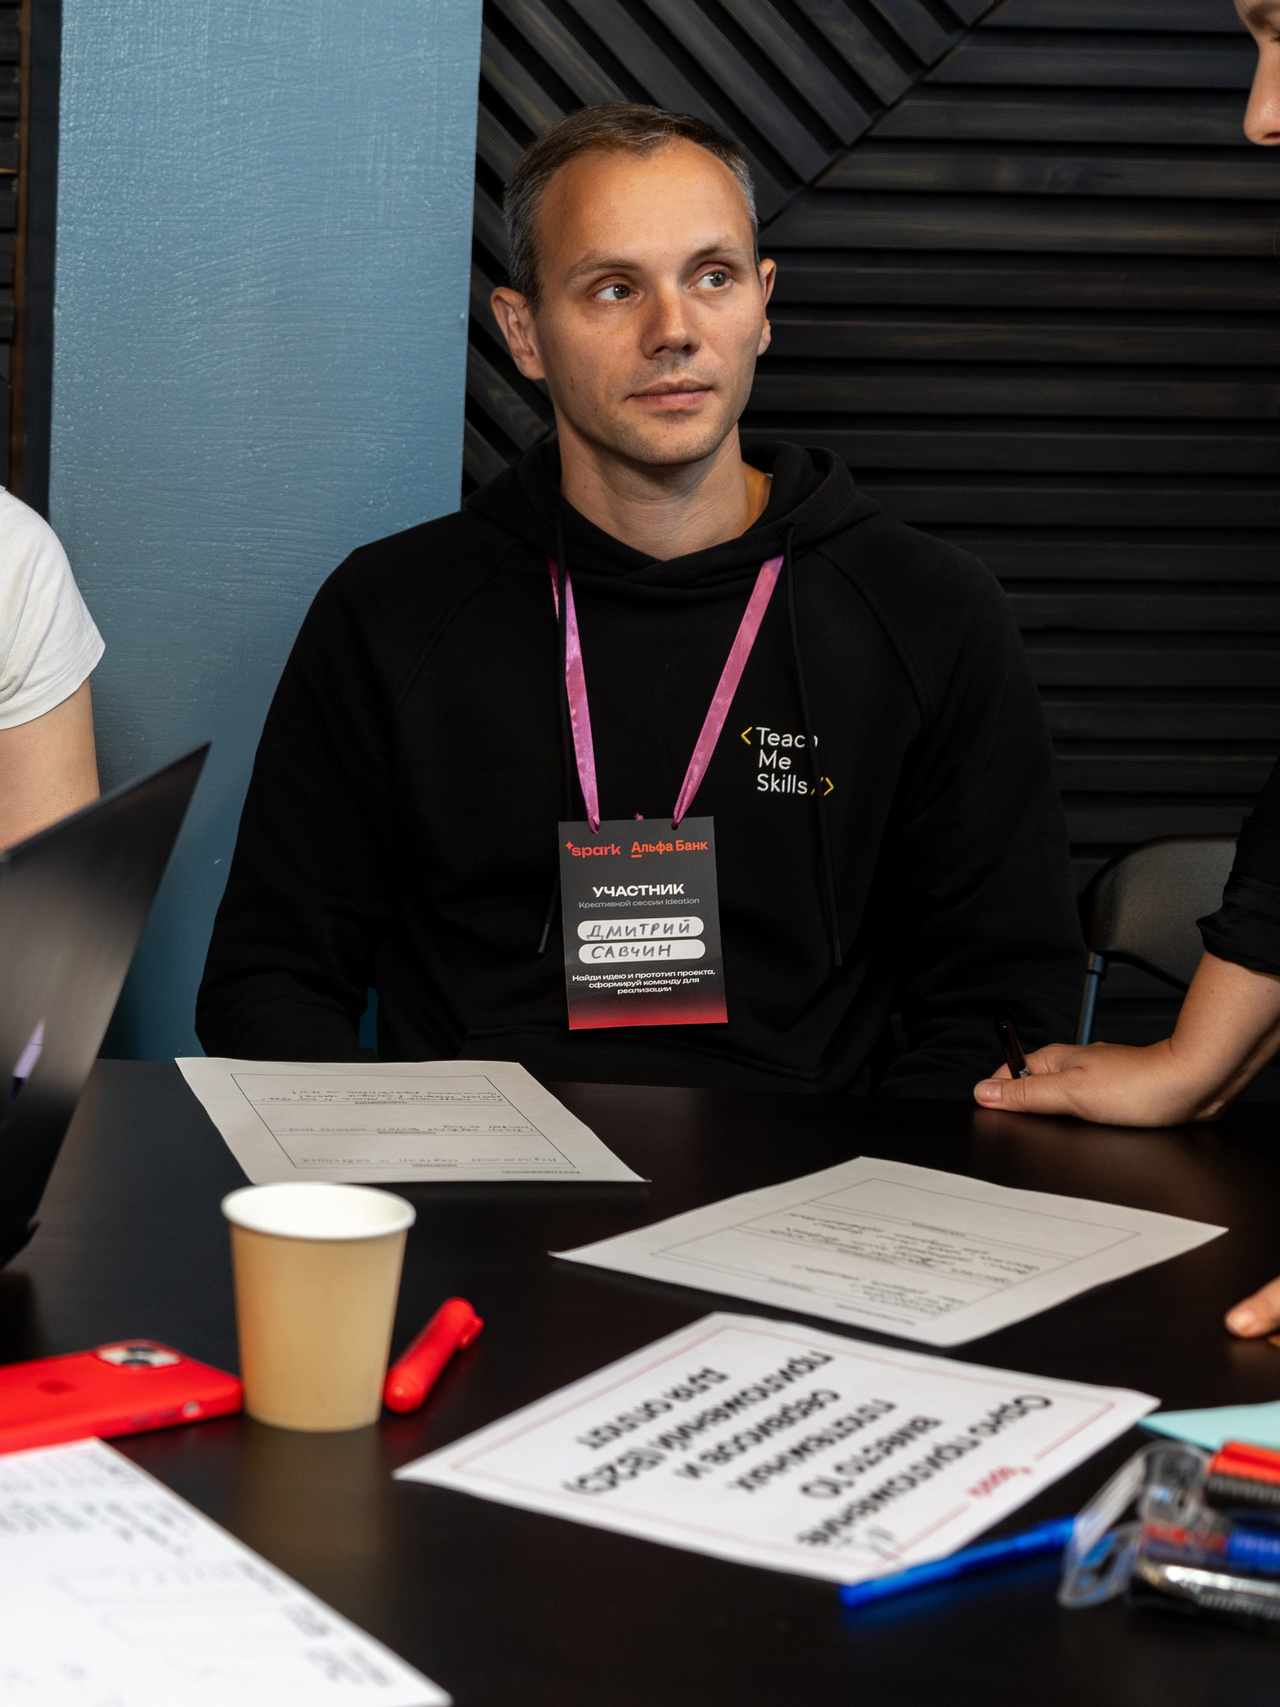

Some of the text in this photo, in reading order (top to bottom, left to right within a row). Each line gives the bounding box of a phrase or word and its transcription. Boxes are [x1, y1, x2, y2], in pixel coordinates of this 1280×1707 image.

[759, 749, 791, 770] Me
[571, 843, 621, 858] spark
[631, 839, 708, 855] Альфа Банк
[592, 883, 685, 898] УЧАСТНИК
[578, 900, 631, 909] Креативной
[665, 897, 700, 906] Ideation
[586, 919, 690, 940] ДМИТРИЙ
[591, 944, 672, 959] САВЧИН
[572, 974, 602, 982] Найди
[603, 973, 627, 981] идею
[634, 971, 676, 979] прототип
[677, 969, 716, 977] проекта,
[588, 977, 700, 989] сформируй команду для
[617, 986, 672, 995] реализации
[967, 1394, 1053, 1437] Одно
[800, 1414, 942, 1500] вместо 10
